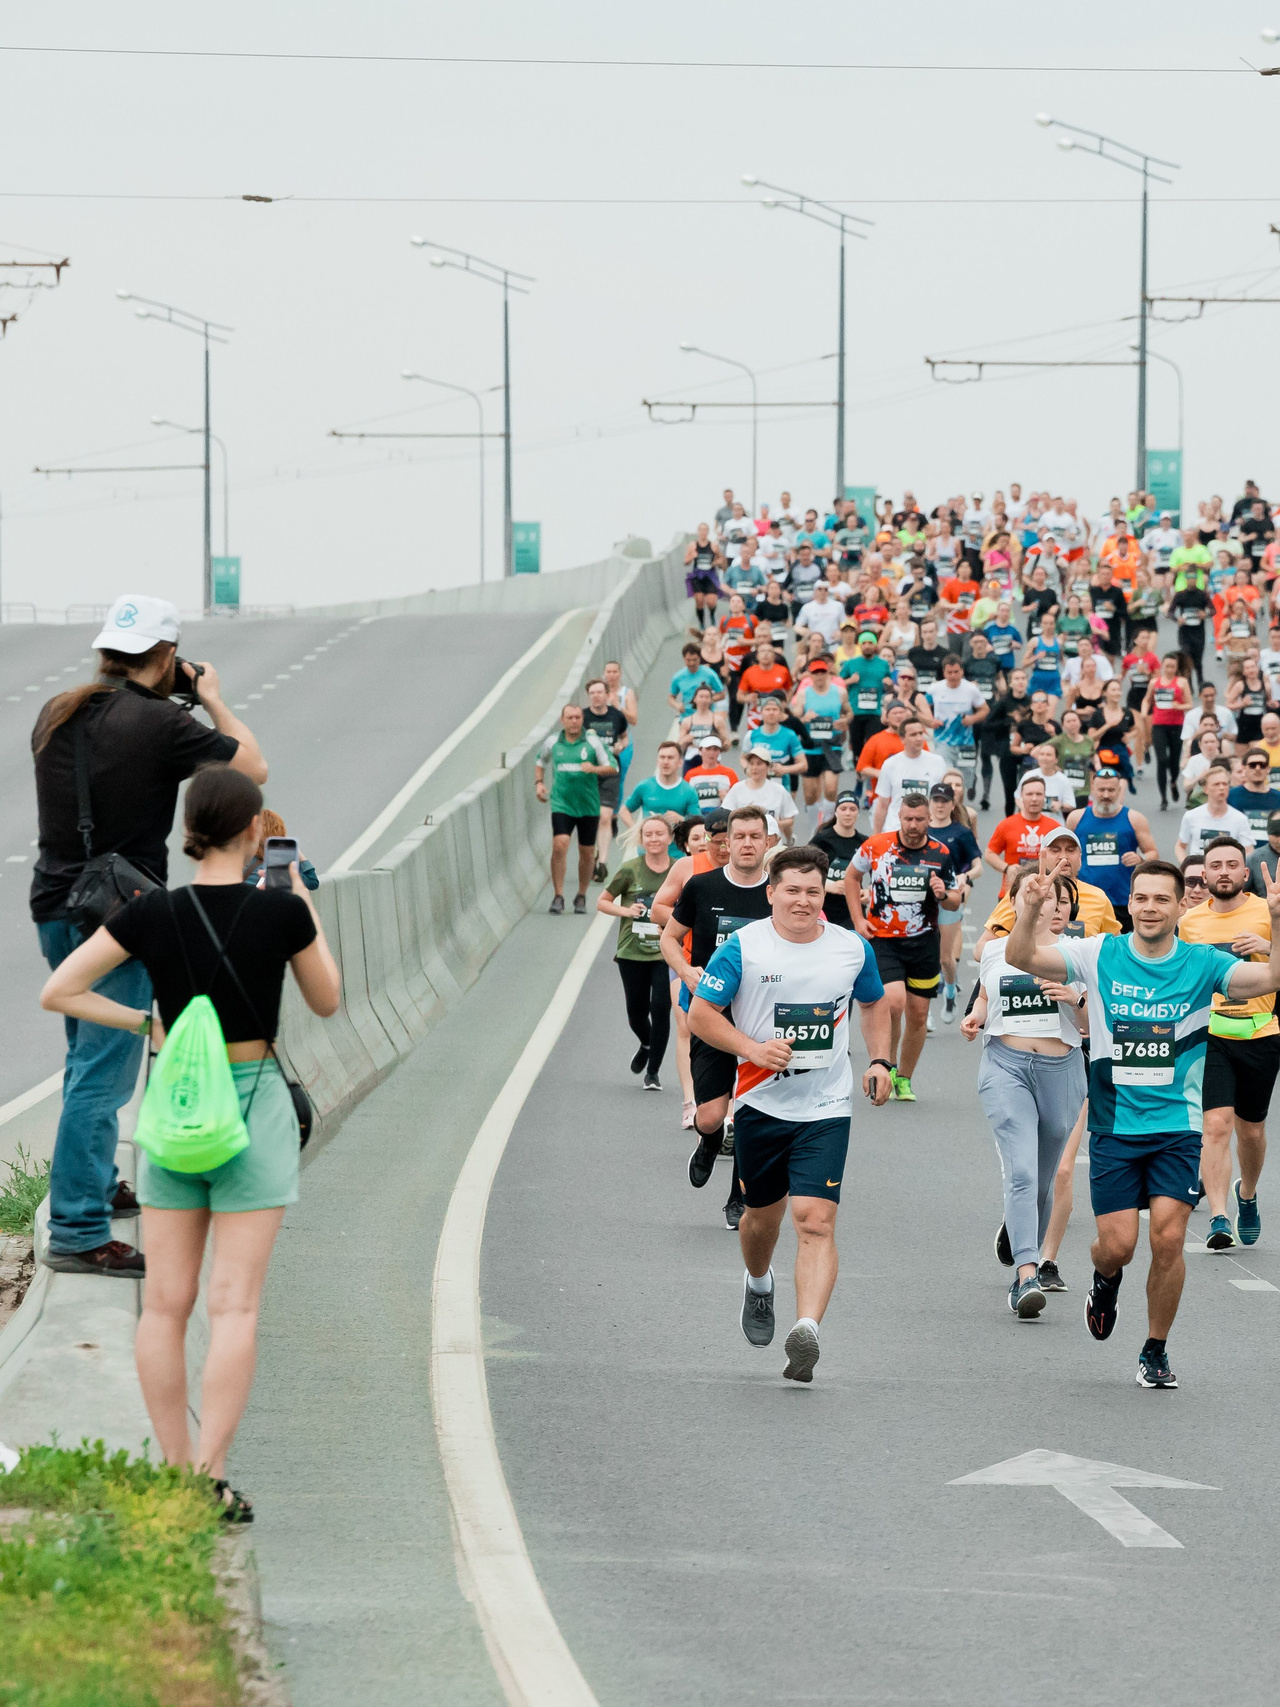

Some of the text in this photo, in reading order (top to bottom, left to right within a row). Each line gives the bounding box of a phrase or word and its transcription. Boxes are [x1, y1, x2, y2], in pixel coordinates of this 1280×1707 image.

[897, 876, 925, 887] 6054
[698, 972, 725, 992] ПСБ
[1111, 980, 1156, 1000] БЕГУ
[1012, 994, 1051, 1009] 8441
[1110, 1002, 1191, 1018] за СИБУР
[785, 1024, 830, 1040] 6570
[1124, 1042, 1170, 1058] 7688
